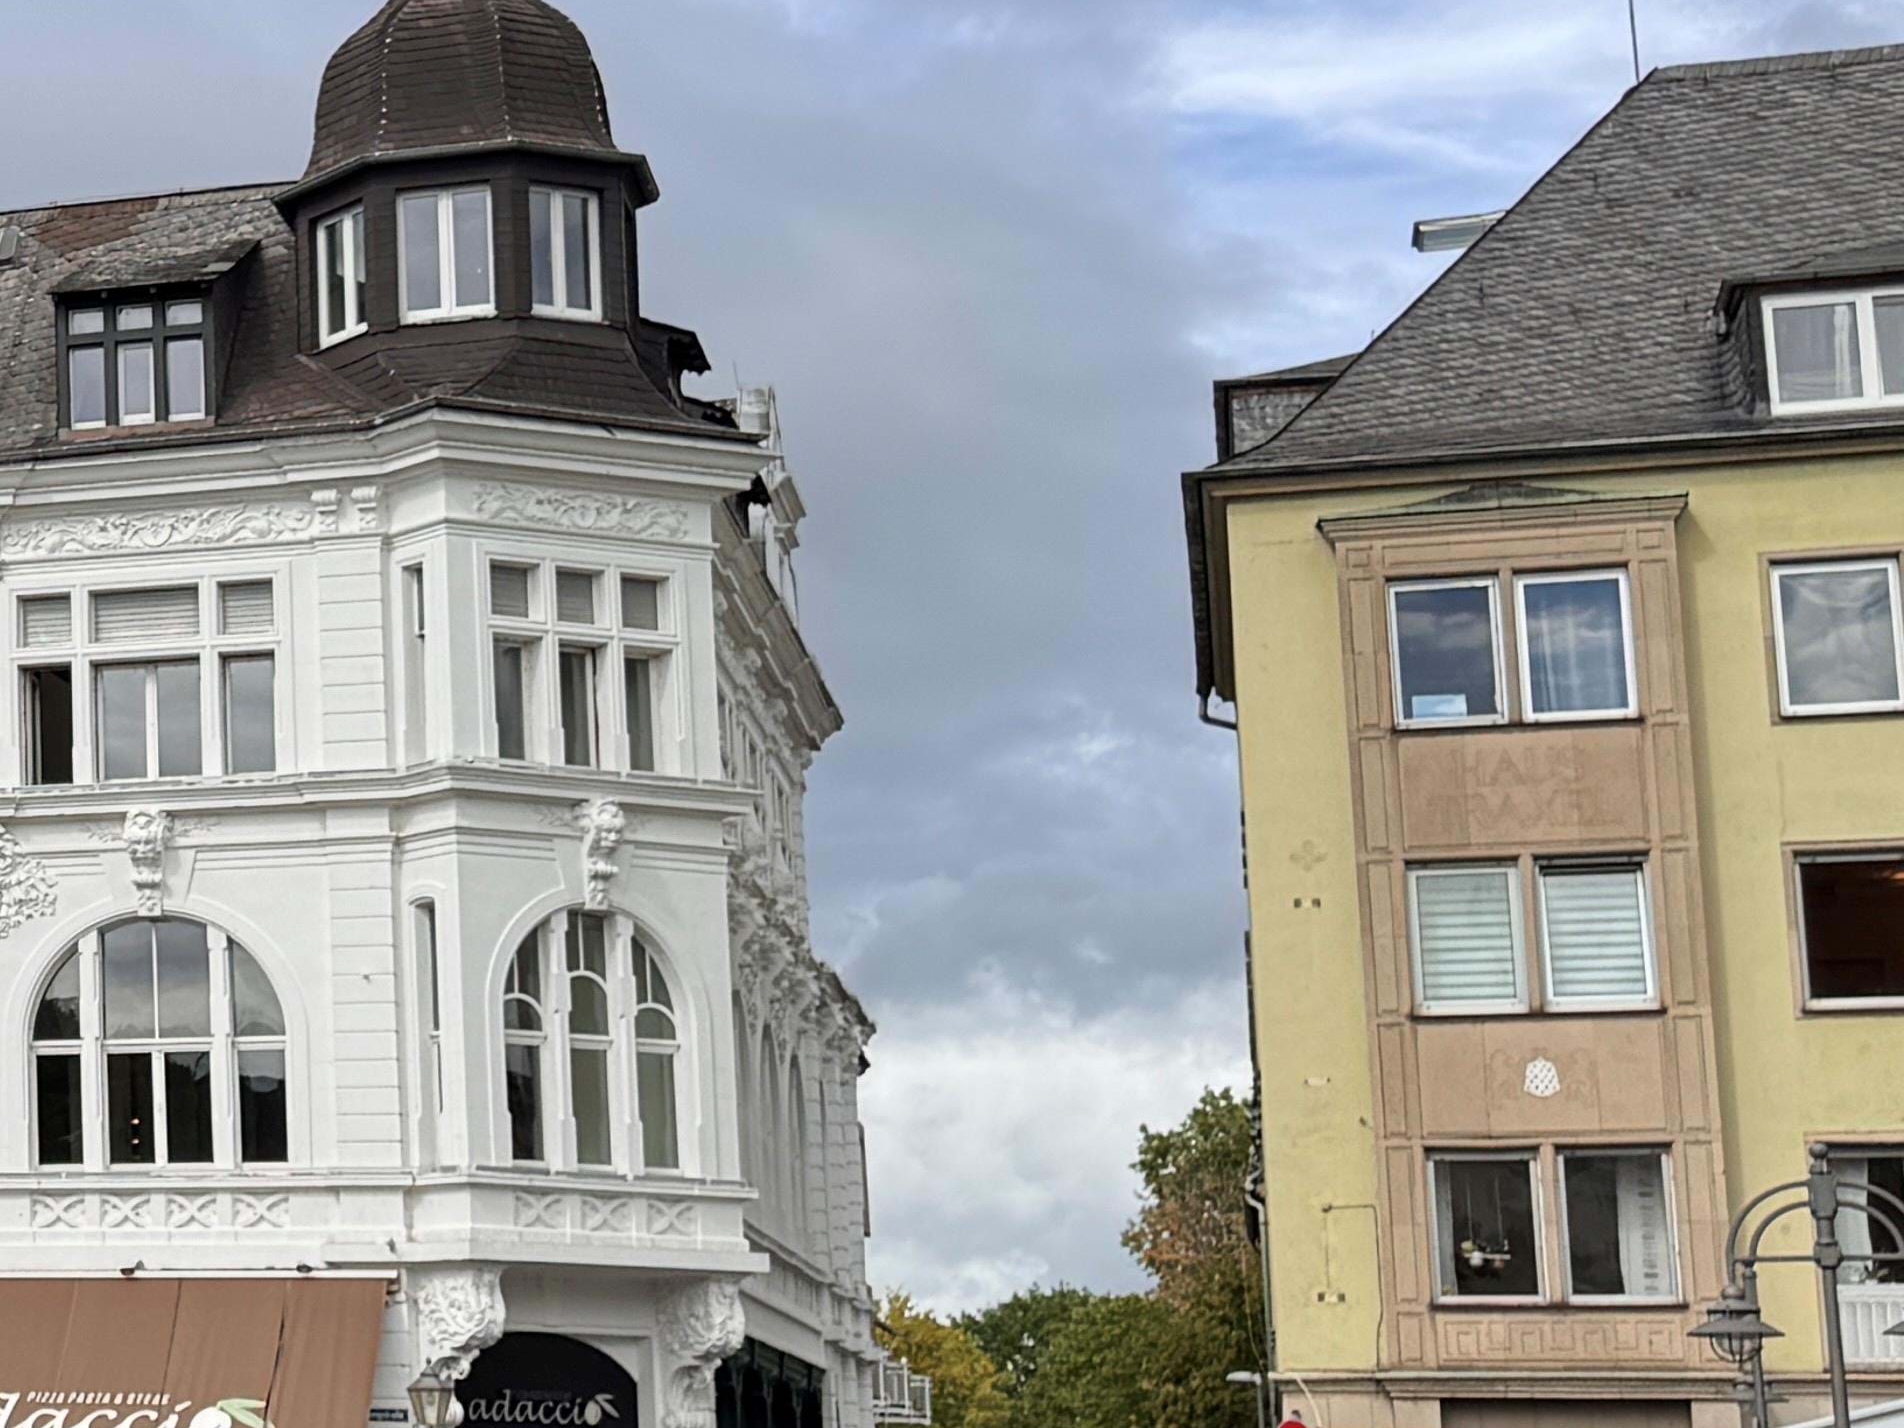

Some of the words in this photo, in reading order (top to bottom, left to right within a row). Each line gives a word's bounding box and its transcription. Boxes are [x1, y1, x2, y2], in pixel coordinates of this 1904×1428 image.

[1450, 746, 1585, 789] HAUS
[26, 1390, 65, 1404] PIZZA
[67, 1391, 111, 1405] PASTA
[468, 1388, 602, 1426] adaccio
